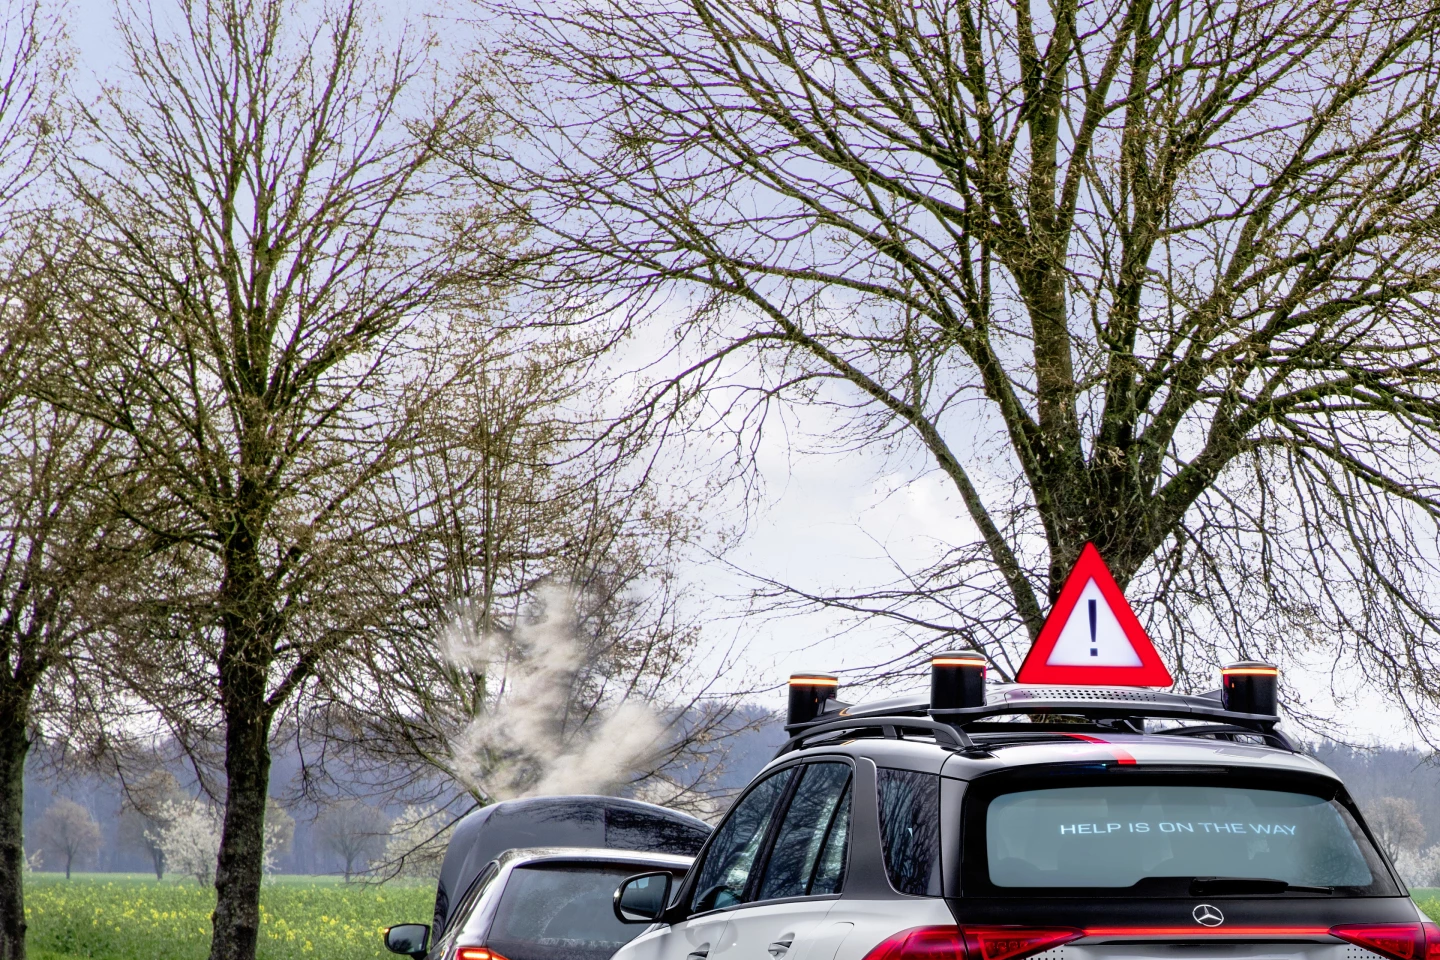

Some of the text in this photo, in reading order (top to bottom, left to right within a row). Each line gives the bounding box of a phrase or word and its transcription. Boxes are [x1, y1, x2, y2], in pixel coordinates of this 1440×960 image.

[1060, 822, 1296, 835] HELP IS ON THE WAY
